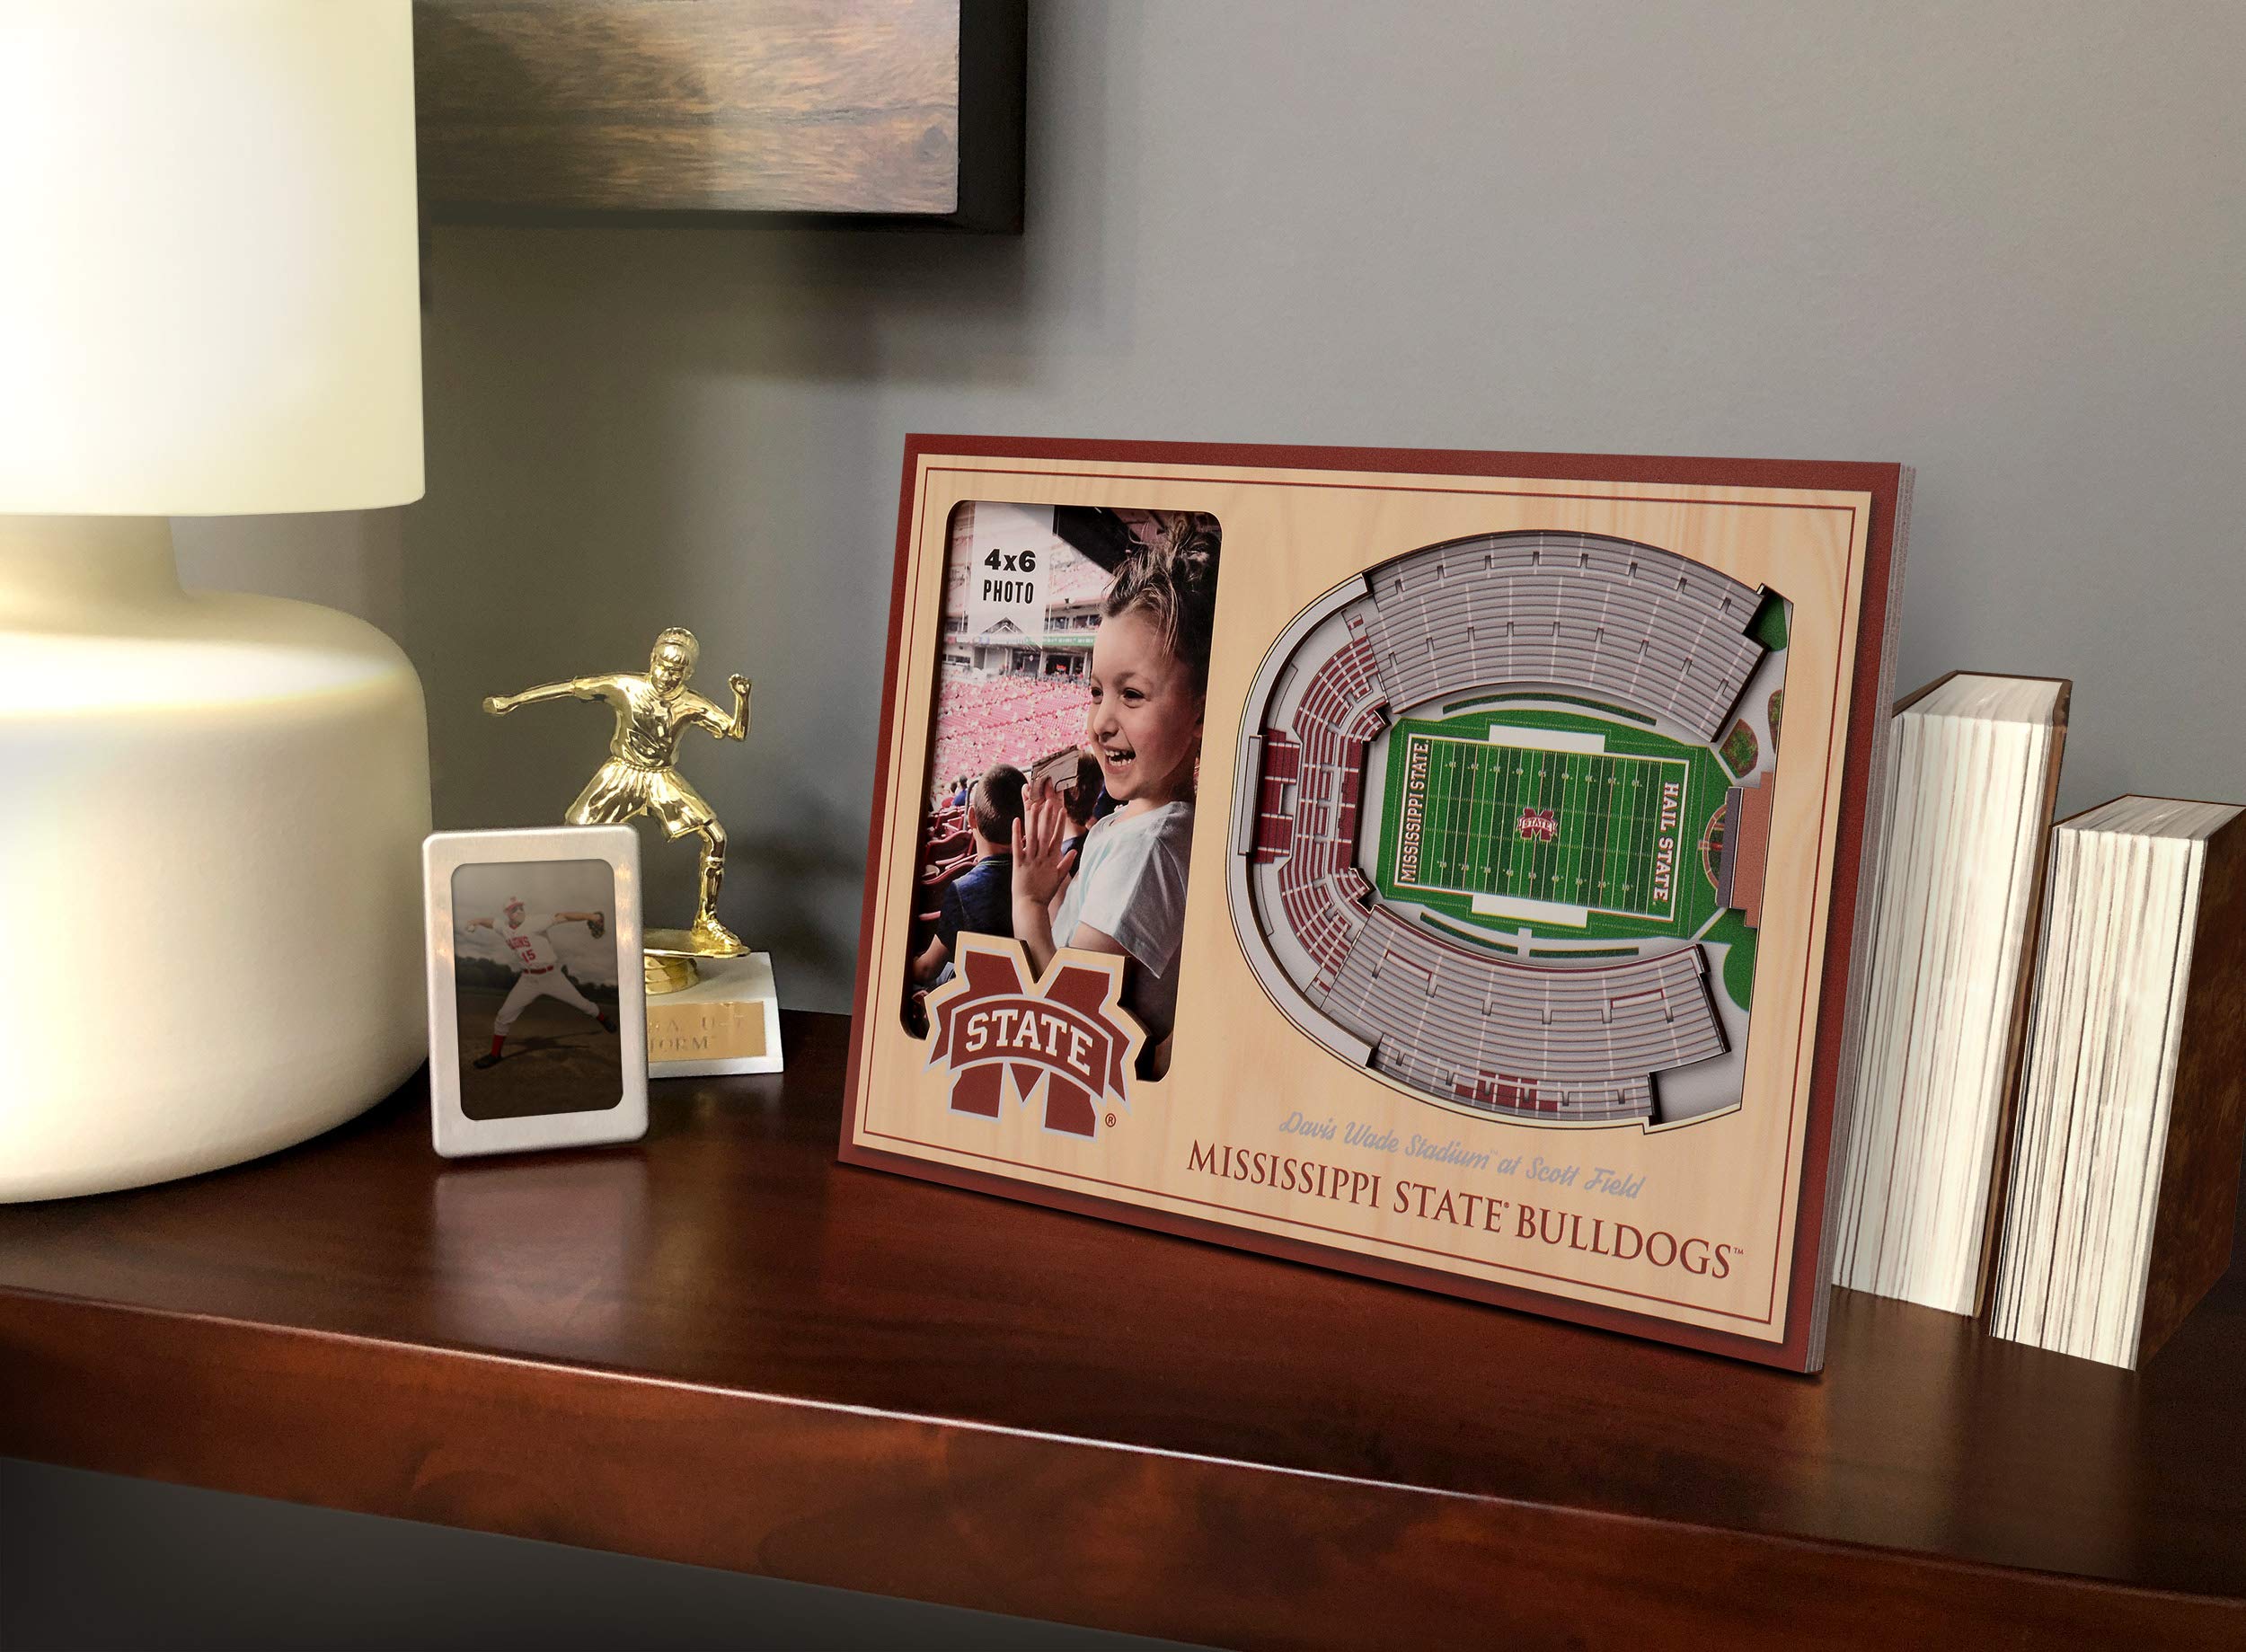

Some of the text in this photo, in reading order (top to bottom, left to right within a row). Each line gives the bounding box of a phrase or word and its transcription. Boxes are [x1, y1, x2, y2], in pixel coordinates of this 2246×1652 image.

[983, 579, 1034, 604] PHOTO
[984, 548, 1036, 572] 4x6
[1401, 792, 1424, 882] MISSISSIPPI
[1653, 782, 1680, 903] HAIL STATE
[521, 949, 536, 964] 15
[965, 1009, 1093, 1076] STATE
[1186, 1139, 1382, 1208] MISSISSIPPI
[1279, 1111, 1338, 1141] Davis
[1343, 1121, 1400, 1153] Wade
[1497, 1155, 1522, 1176] at
[1525, 1156, 1581, 1187] Scott
[1584, 1167, 1647, 1199] Field
